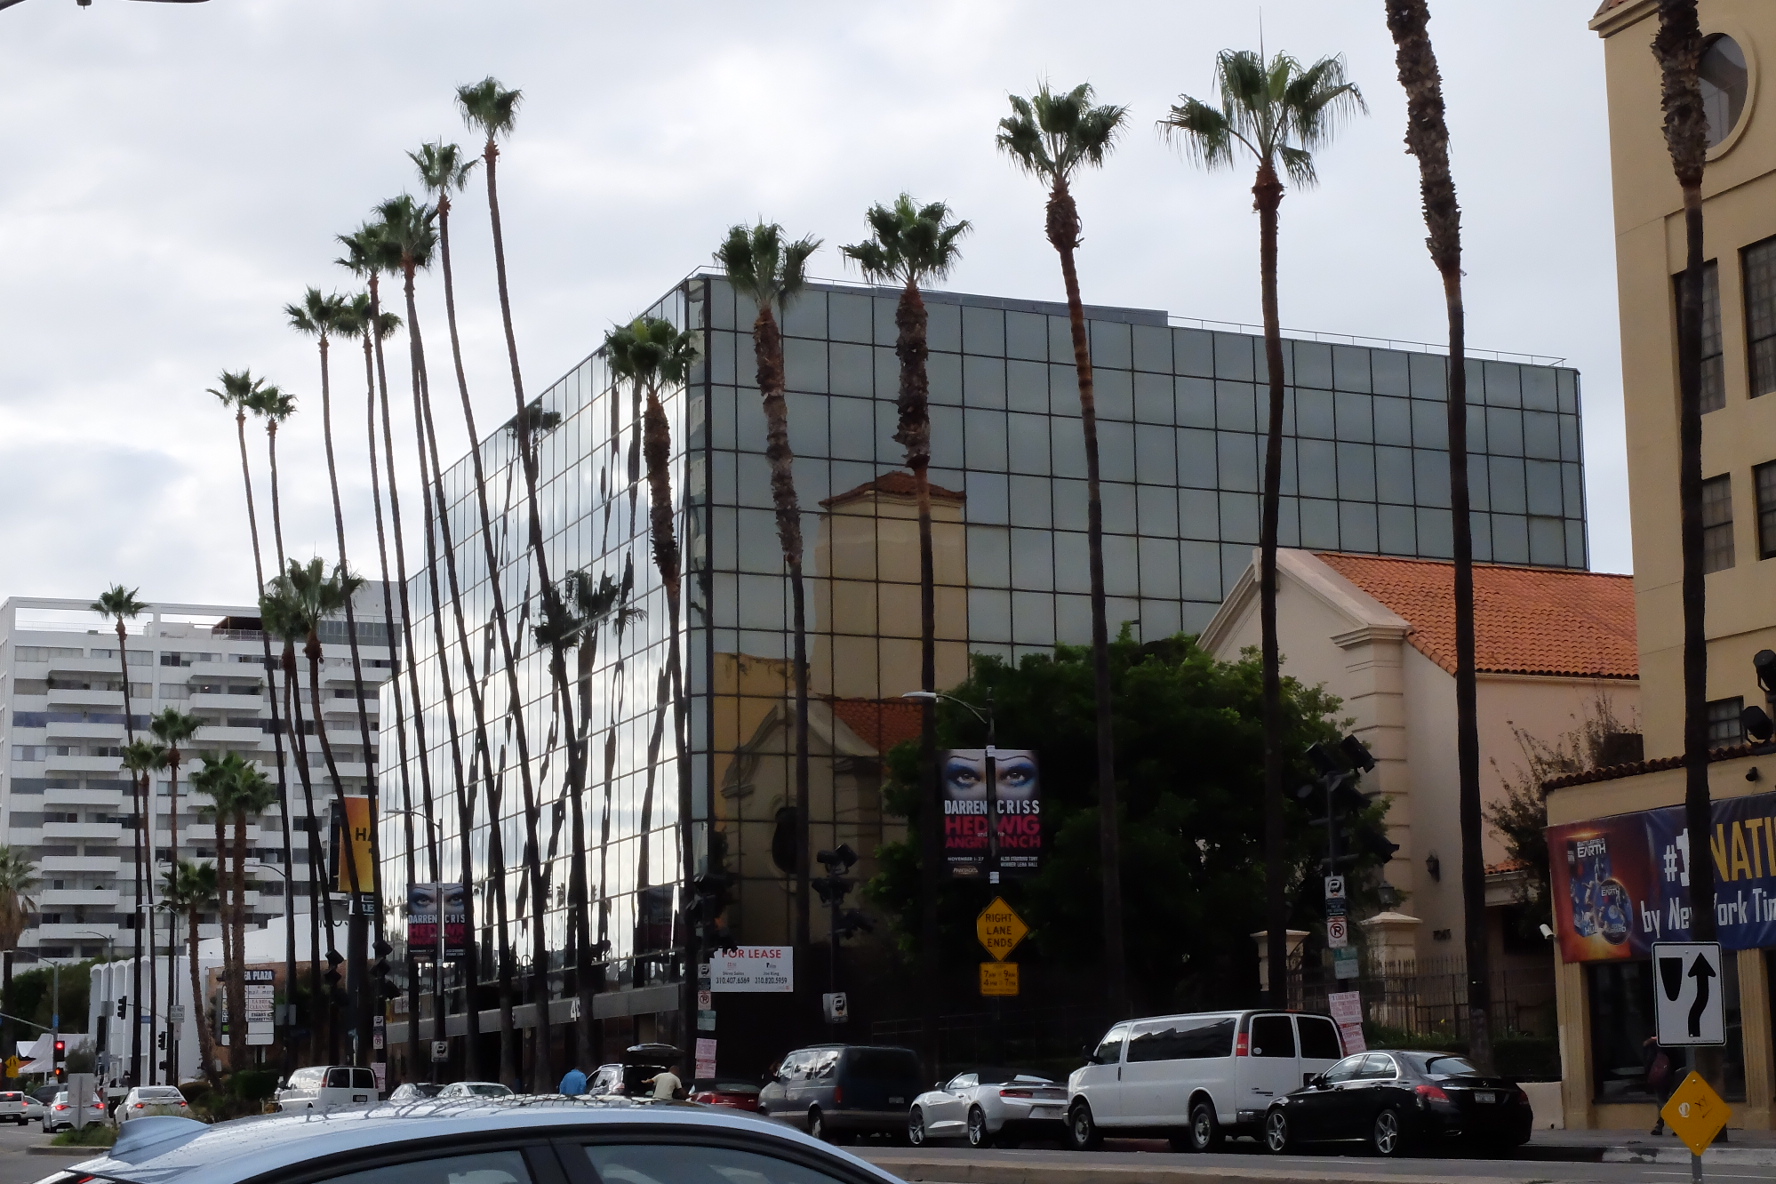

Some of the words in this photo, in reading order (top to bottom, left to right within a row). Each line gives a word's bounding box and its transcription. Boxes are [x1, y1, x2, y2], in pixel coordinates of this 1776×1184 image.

[944, 800, 988, 814] DARREN
[997, 800, 1040, 814] CRISS
[945, 836, 989, 848] ANGRY
[1000, 836, 1041, 848] INCH
[1577, 843, 1606, 858] EARTH
[1709, 816, 1776, 882] NATI
[408, 914, 438, 924] DARREN
[985, 913, 1012, 922] RIGHT
[1640, 900, 1660, 938] by
[1668, 897, 1693, 930] Ne
[1713, 890, 1748, 926] ork
[986, 925, 1012, 935] LANE
[987, 938, 1013, 948] ENDS
[749, 950, 781, 958] LEASE
[253, 971, 272, 980] PLAZA
